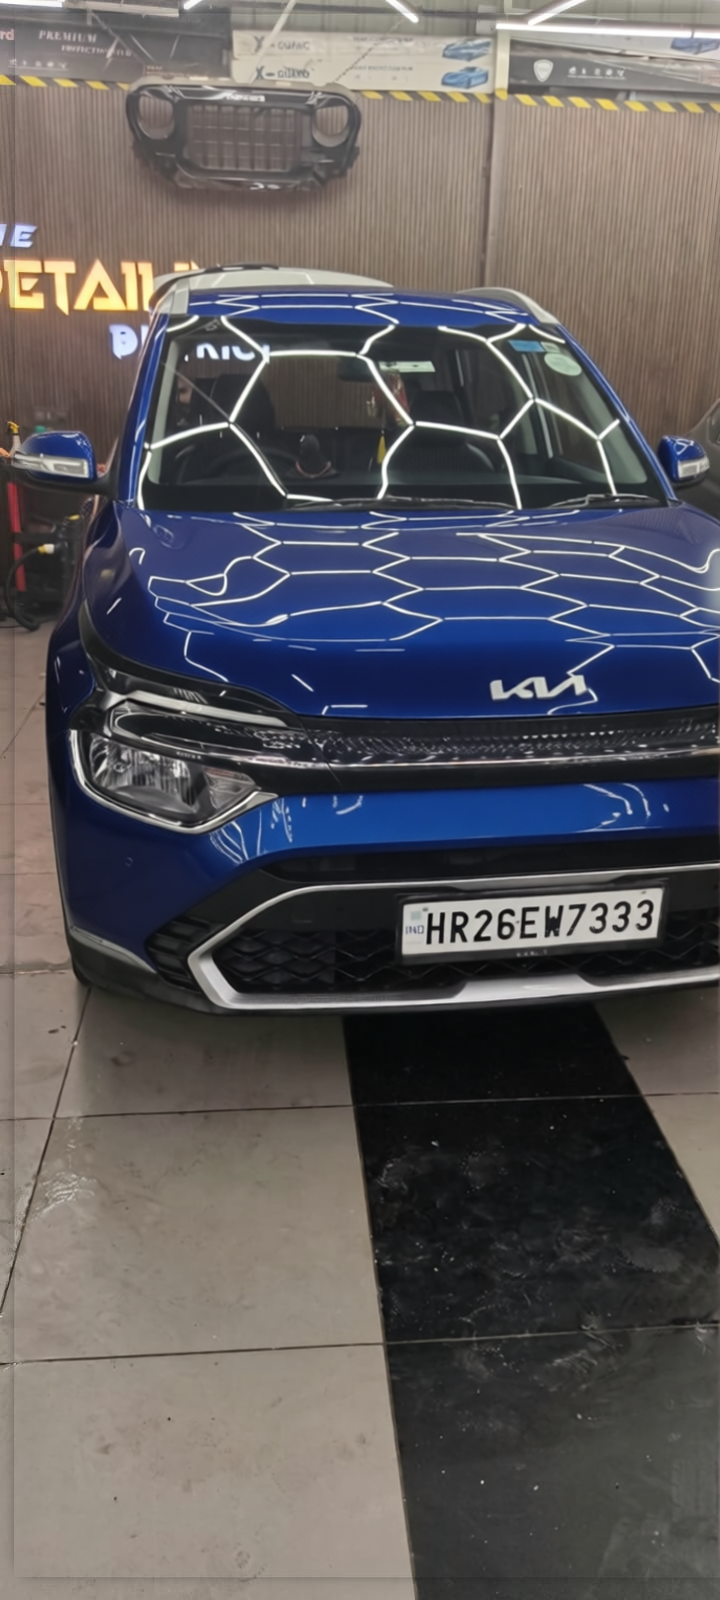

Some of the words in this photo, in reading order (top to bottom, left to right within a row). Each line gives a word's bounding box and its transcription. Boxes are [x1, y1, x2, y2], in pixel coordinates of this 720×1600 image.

[38, 30, 97, 43] PREMIUM
[490, 675, 587, 700] KIA
[426, 899, 654, 945] HR26EW7333
